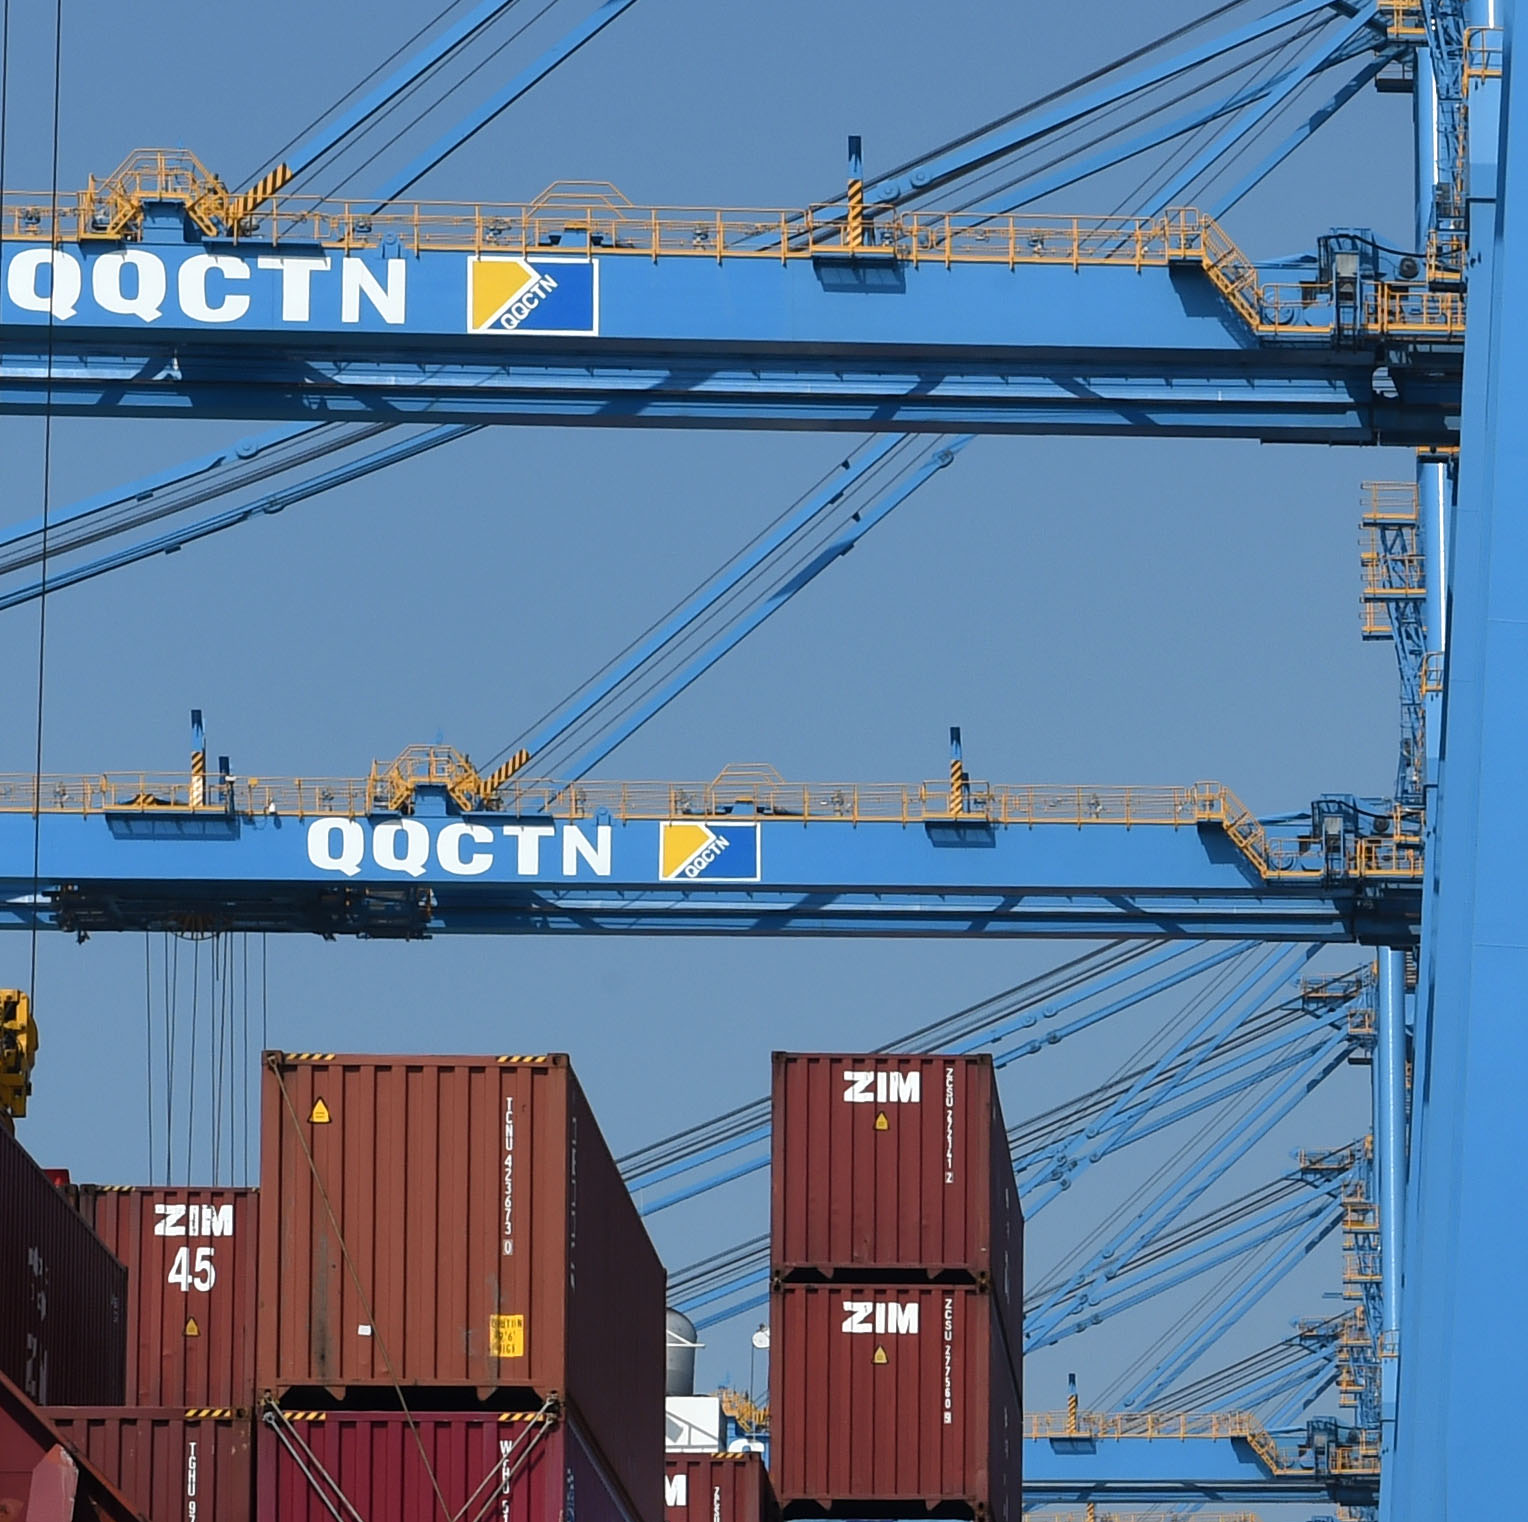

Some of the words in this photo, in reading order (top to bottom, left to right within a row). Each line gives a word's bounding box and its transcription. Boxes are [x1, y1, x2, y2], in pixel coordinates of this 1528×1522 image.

[6, 248, 407, 324] QQCTN
[500, 274, 558, 331] QQCTN
[307, 817, 612, 877] QQCTN
[685, 834, 731, 878] QQCTN
[843, 1070, 920, 1103] ZIM
[945, 1067, 954, 1107] ZCSU
[504, 1097, 513, 1151] TCNU
[504, 1154, 513, 1235] 423673
[154, 1203, 234, 1237] ZIM
[167, 1246, 217, 1292] 45
[841, 1301, 919, 1335] ZIM
[944, 1298, 953, 1341] ZCSU
[944, 1345, 952, 1409] 277560
[187, 1442, 197, 1497] TGHU
